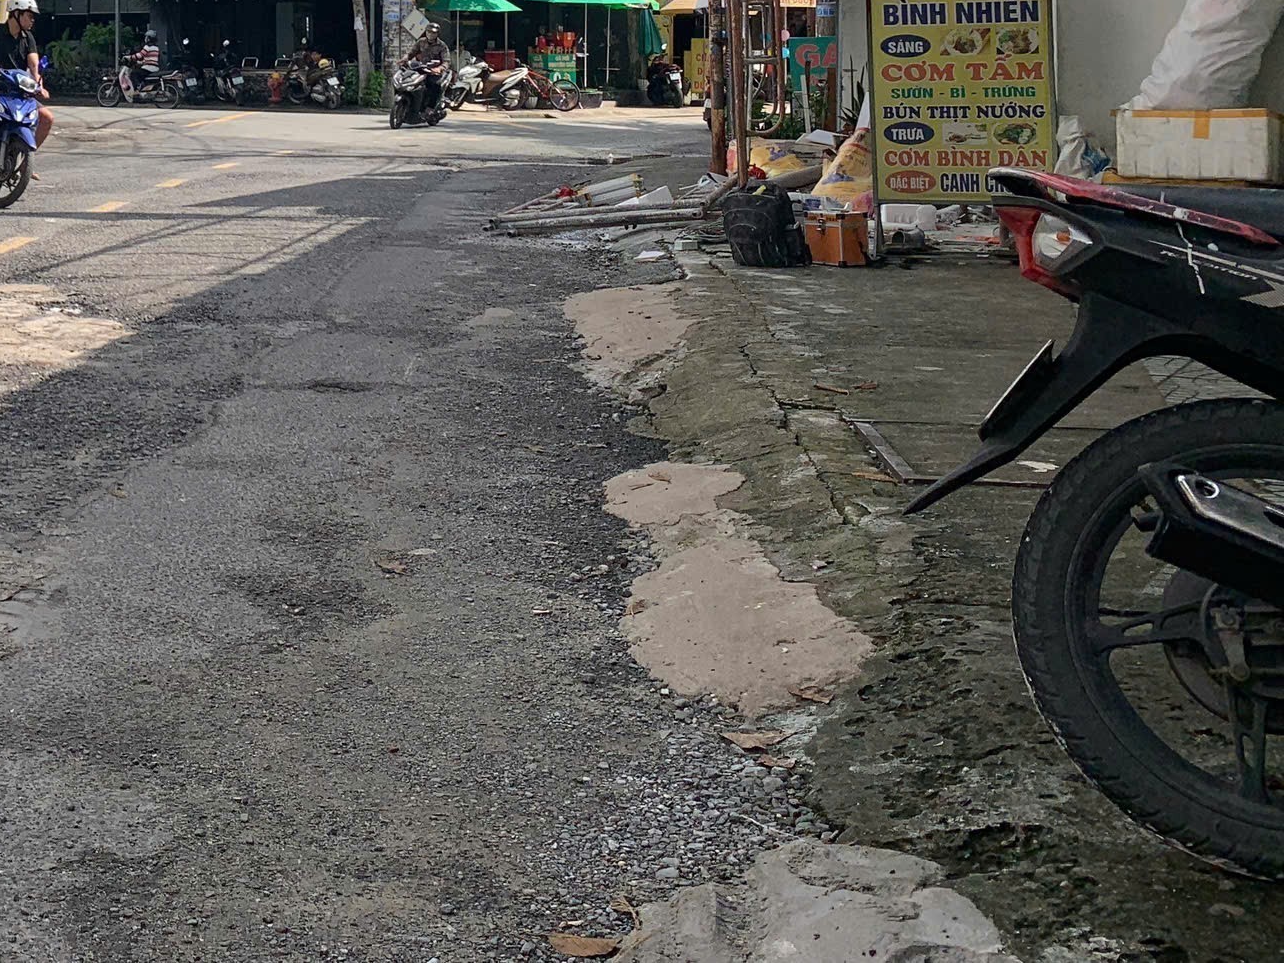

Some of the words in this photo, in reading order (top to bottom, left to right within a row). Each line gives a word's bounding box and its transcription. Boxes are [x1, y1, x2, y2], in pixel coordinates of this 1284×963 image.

[883, 0, 947, 25] BÌNH
[887, 37, 924, 54] SÁNG
[881, 61, 955, 82] CƠM
[966, 53, 1045, 82] TẤM
[950, 85, 966, 98] BÌ
[982, 85, 1036, 98] TRỨNG
[883, 102, 921, 119] BÚN
[927, 104, 971, 123] THỊT
[976, 101, 1046, 119] NƯỚNG
[891, 127, 925, 141] TRƯA
[884, 147, 931, 167] CƠM
[936, 146, 991, 167] BÌNH
[997, 145, 1048, 167] DÂN
[890, 175, 908, 191] ĐẶC
[910, 175, 930, 191] BIỆT
[940, 172, 980, 193] CANH
